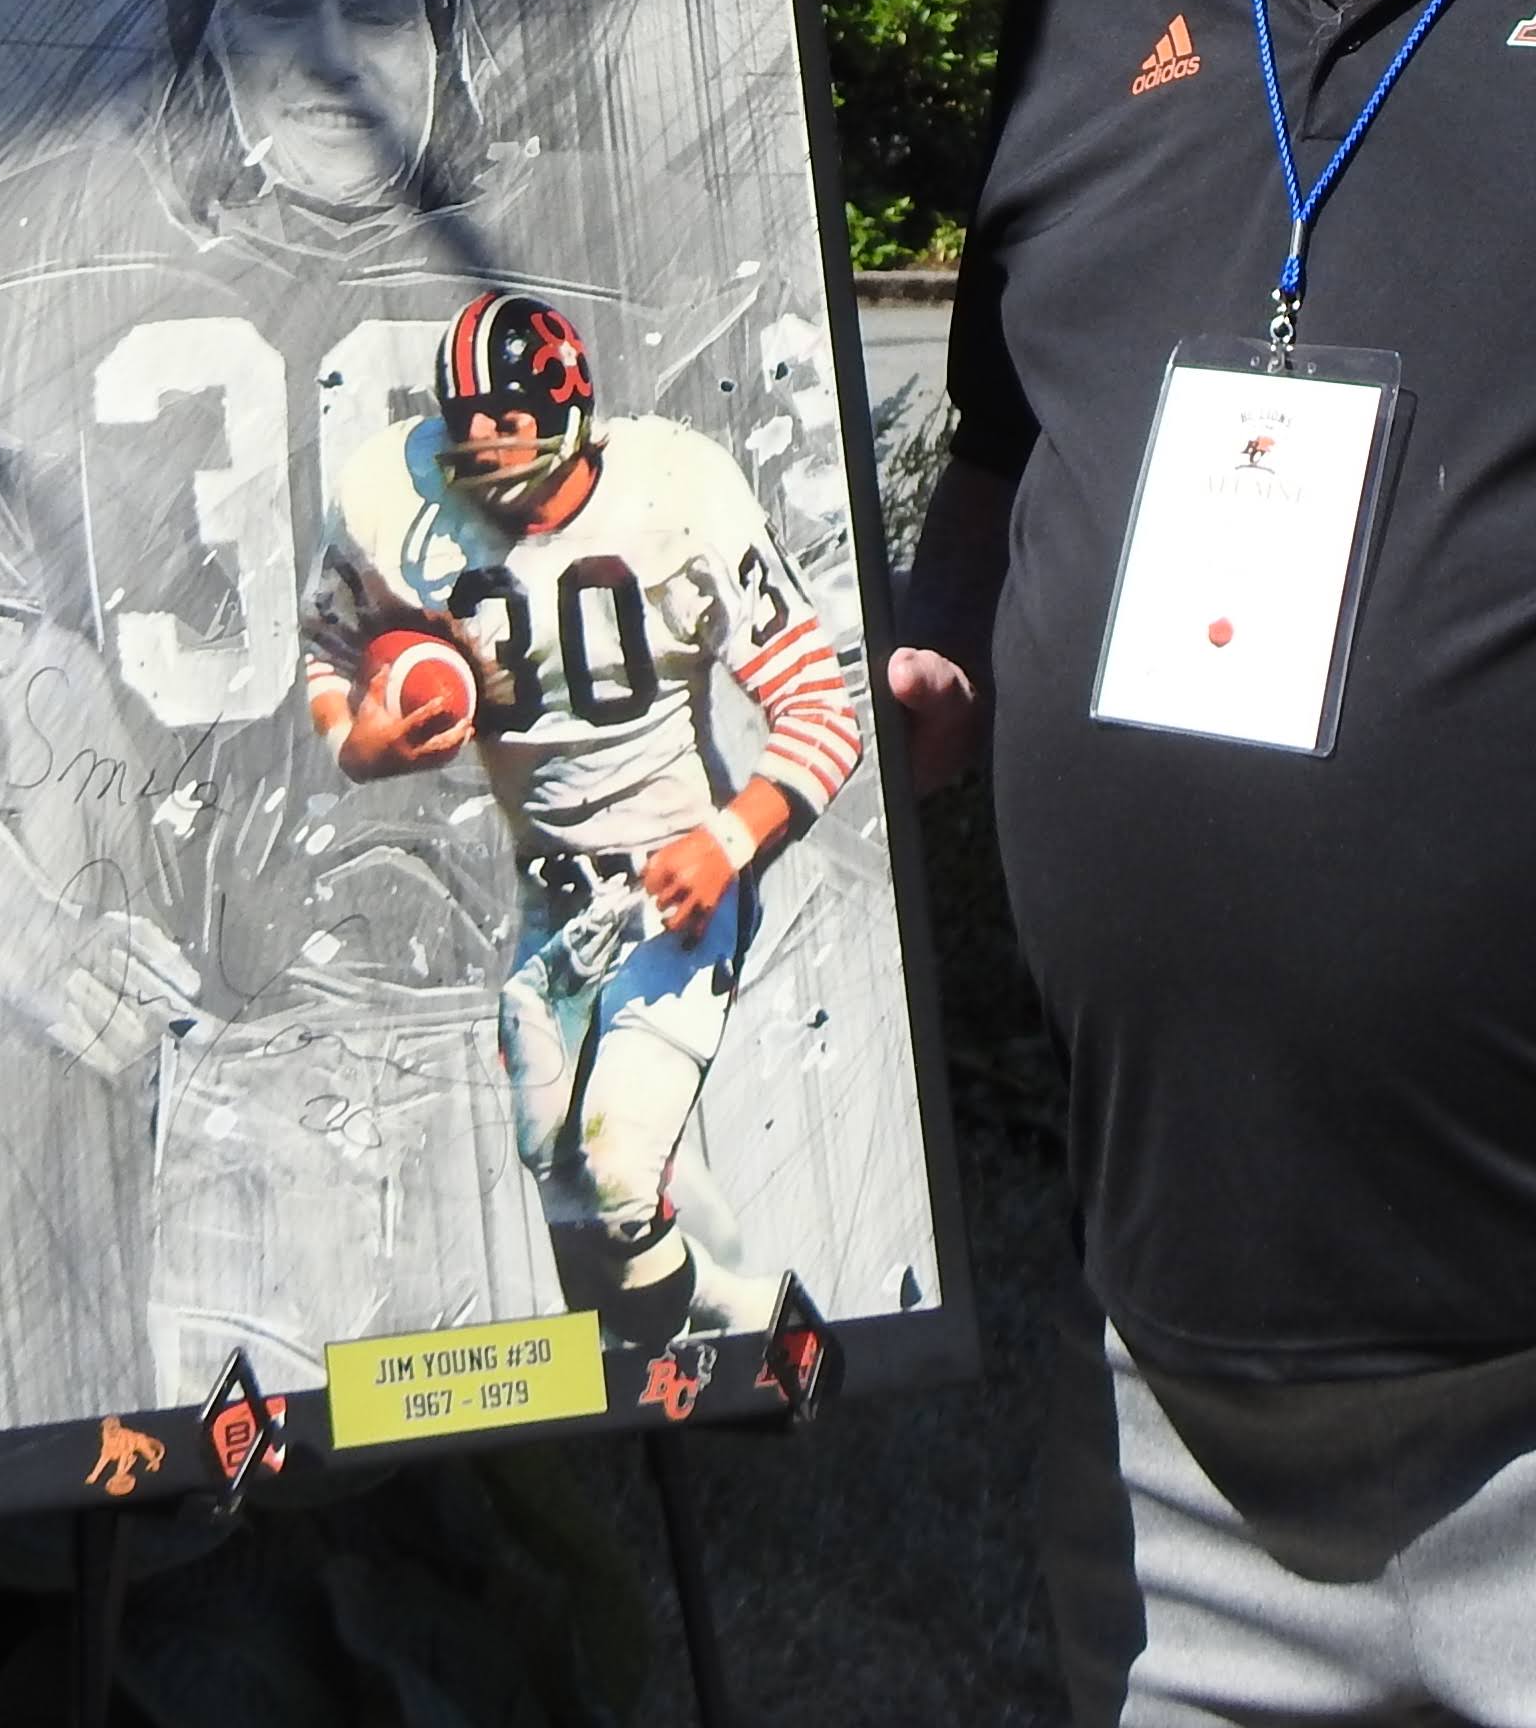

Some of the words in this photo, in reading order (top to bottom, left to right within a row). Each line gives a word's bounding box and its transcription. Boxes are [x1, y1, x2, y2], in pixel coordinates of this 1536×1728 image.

[1131, 56, 1201, 95] adidas
[448, 554, 660, 734] 30
[375, 1355, 415, 1385] JIM
[422, 1345, 498, 1378] YOUNG
[507, 1338, 551, 1367] #30
[404, 1389, 453, 1420] 1967
[480, 1379, 529, 1409] 1979
[638, 1358, 699, 1421] BC
